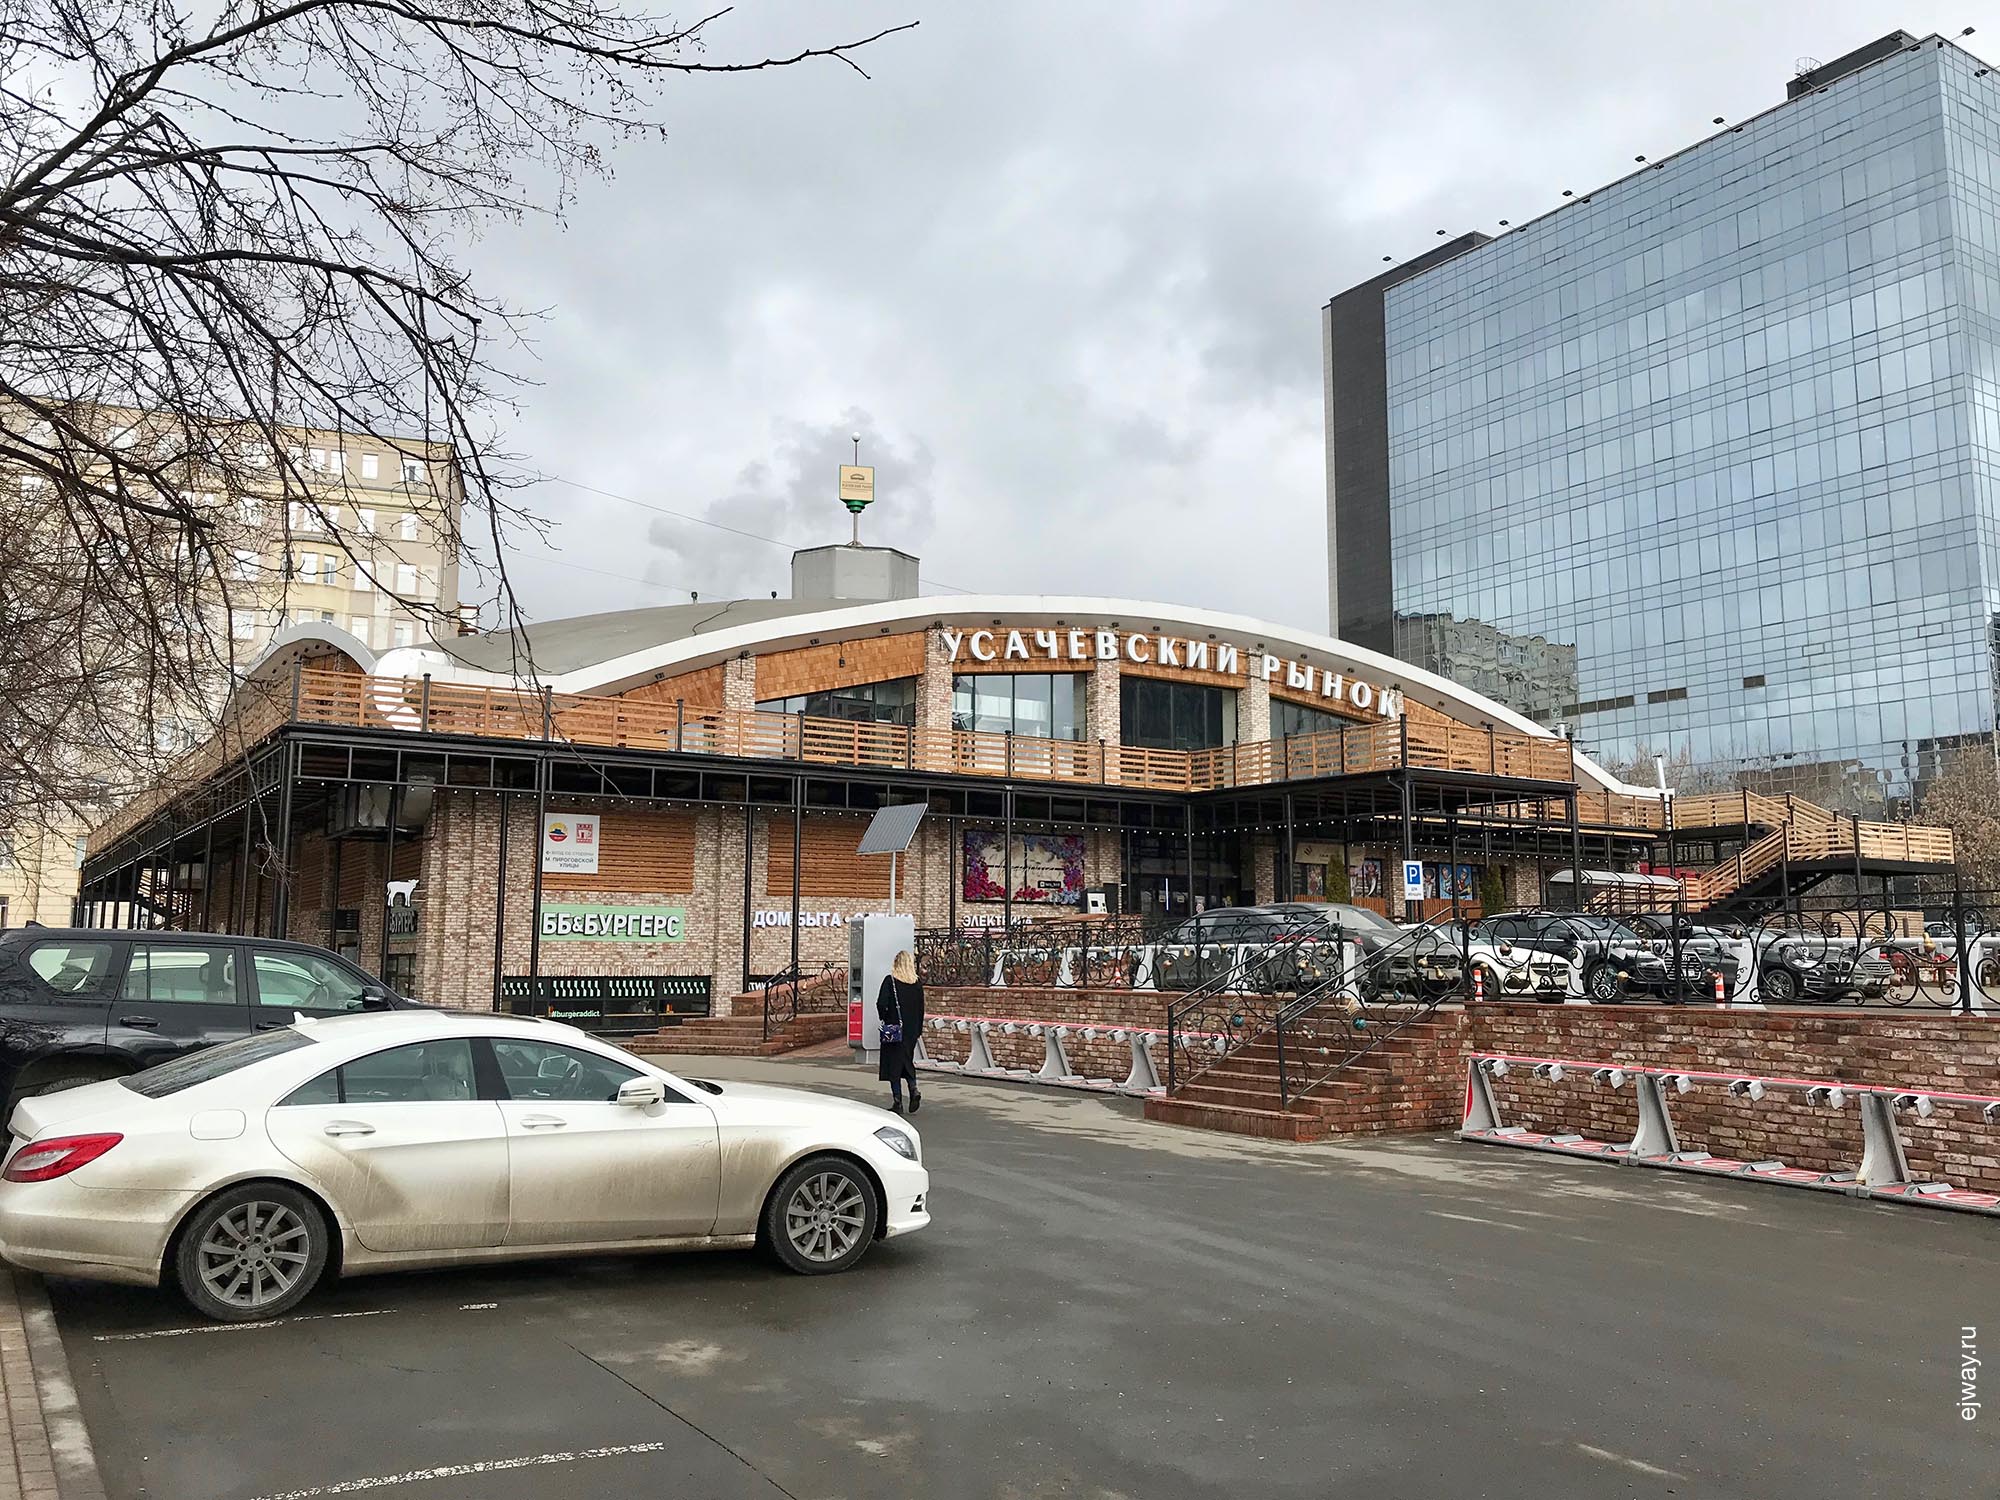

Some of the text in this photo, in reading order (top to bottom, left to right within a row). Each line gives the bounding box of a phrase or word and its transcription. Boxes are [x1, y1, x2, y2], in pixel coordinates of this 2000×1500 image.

[942, 626, 1396, 721] УСАЧЁВСКИЙ РЫНОК
[541, 912, 680, 937] ББ&БУРГЕРС
[752, 911, 791, 928] ДОМ
[798, 911, 841, 928] БЫТА
[552, 1010, 601, 1019] #burgeraddict
